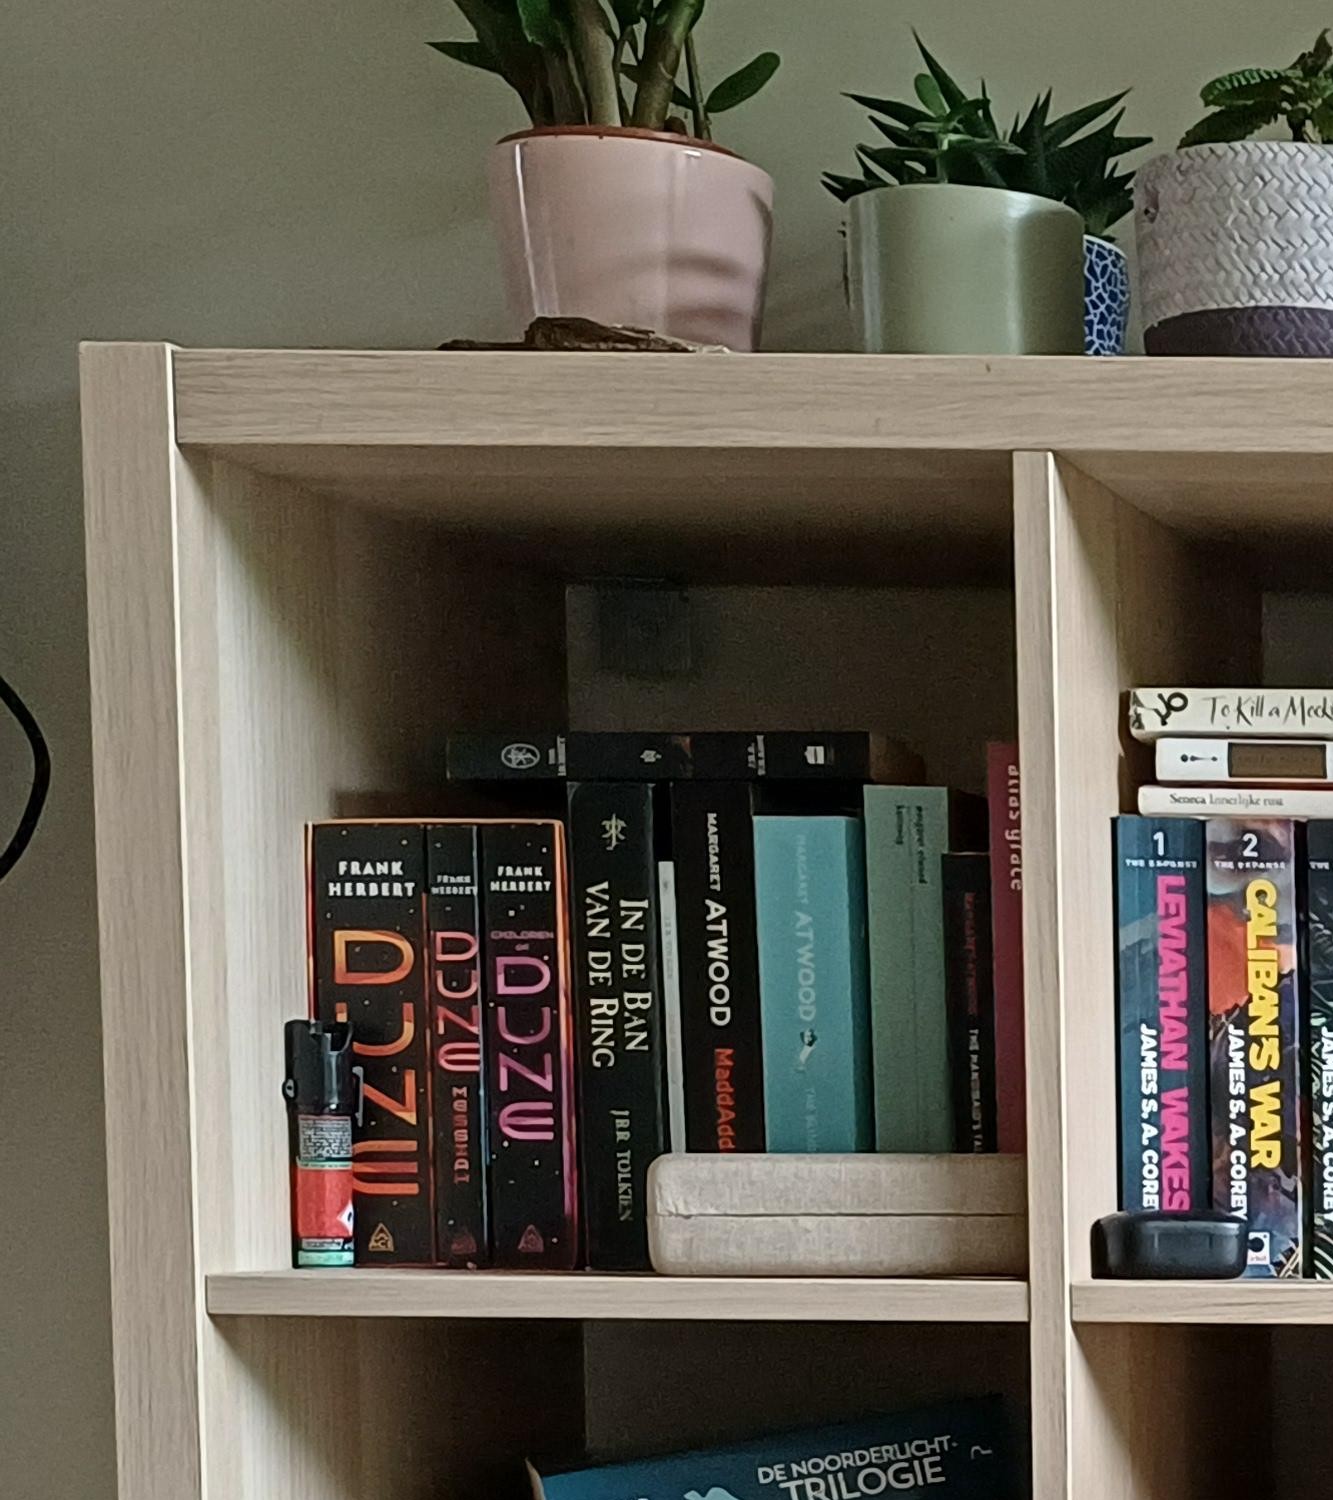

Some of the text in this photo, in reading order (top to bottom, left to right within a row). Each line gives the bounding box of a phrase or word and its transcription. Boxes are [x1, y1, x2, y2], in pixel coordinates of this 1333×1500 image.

[329, 882, 416, 897] HERBERT
[338, 861, 403, 876] FRANK
[1242, 835, 1259, 858] 2
[584, 881, 619, 1069] VAN DE RING
[620, 899, 652, 1053] IN DE BAN
[705, 899, 730, 1028] ATWOOD
[1245, 878, 1281, 1169] CALIBAN'S WAR
[495, 957, 554, 1141] DUNE
